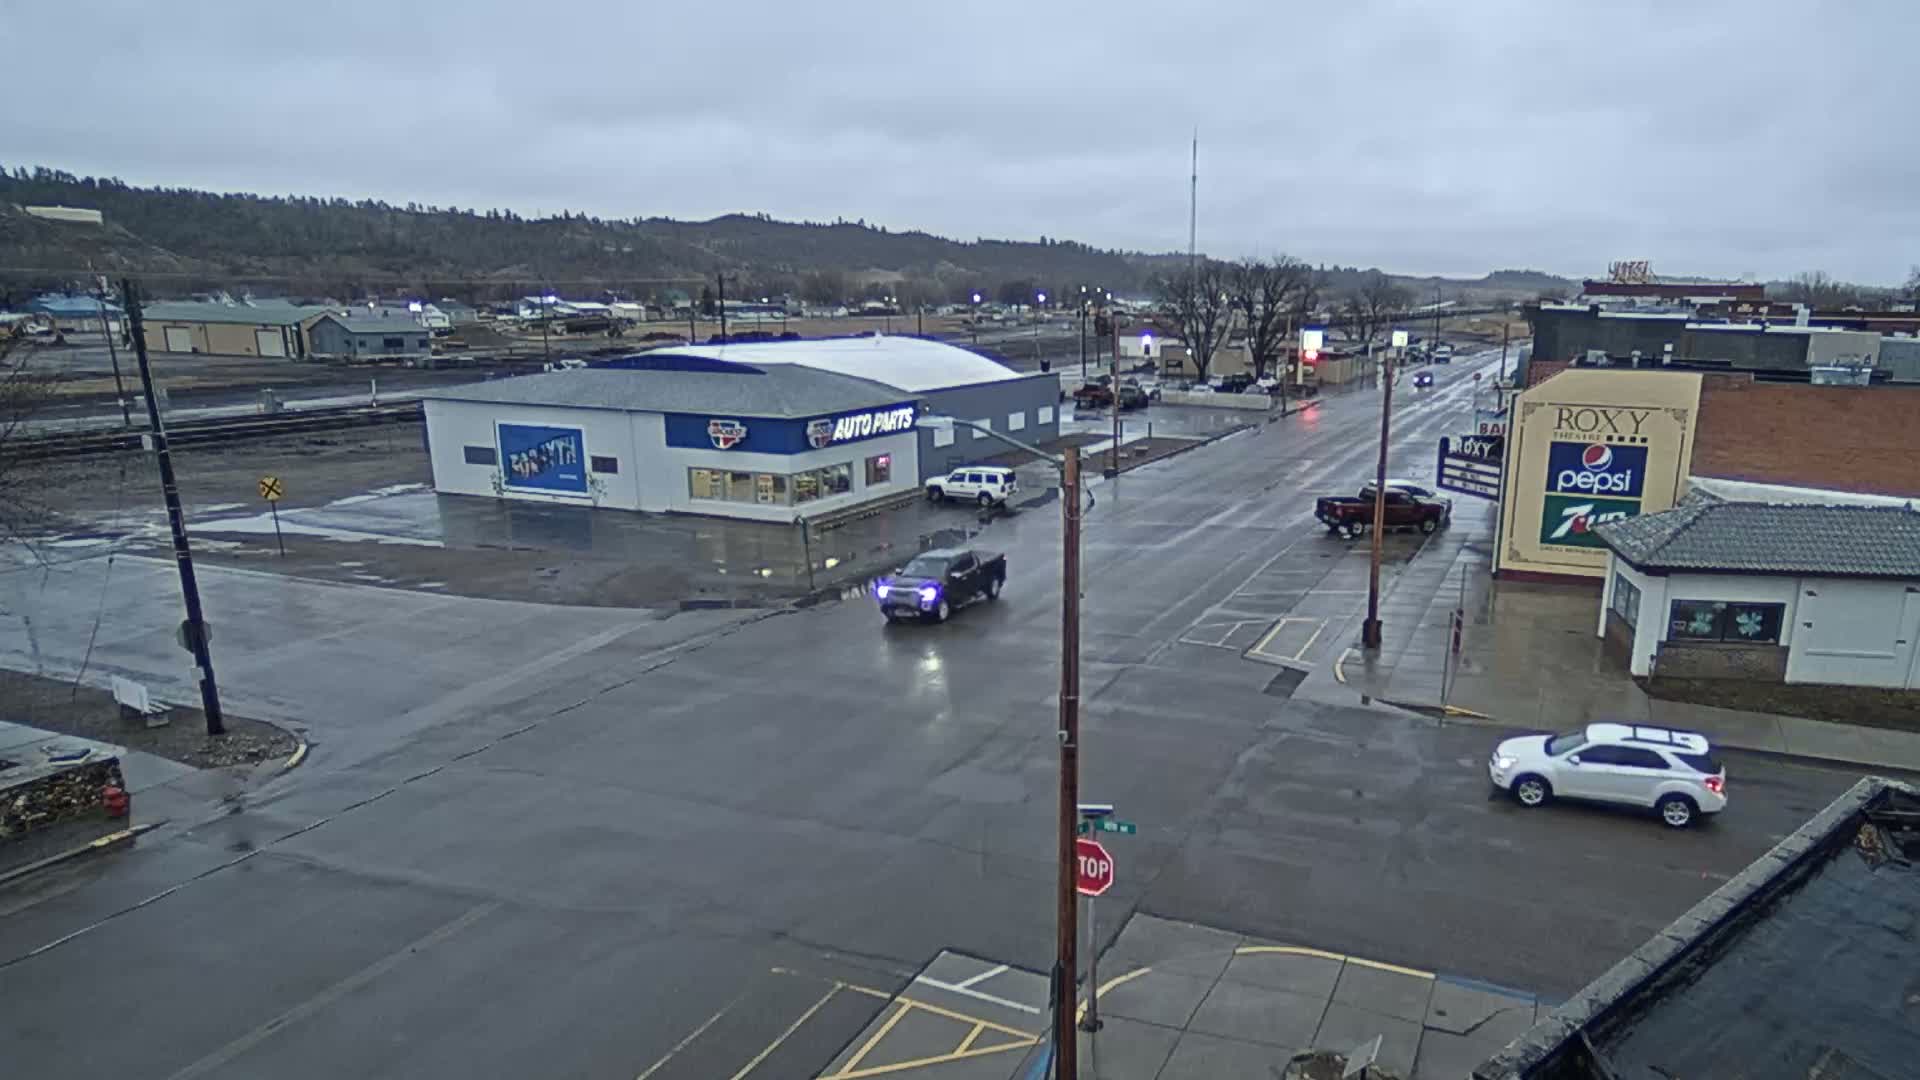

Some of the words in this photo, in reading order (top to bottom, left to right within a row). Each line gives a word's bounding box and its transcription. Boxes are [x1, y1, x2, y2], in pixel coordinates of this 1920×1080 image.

[833, 413, 872, 441] AUTO
[872, 407, 914, 434] PARTS
[1552, 407, 1650, 434] ROXY
[1449, 436, 1496, 457] ROXY
[1557, 469, 1632, 494] pepsi
[1077, 856, 1109, 880] TOP
